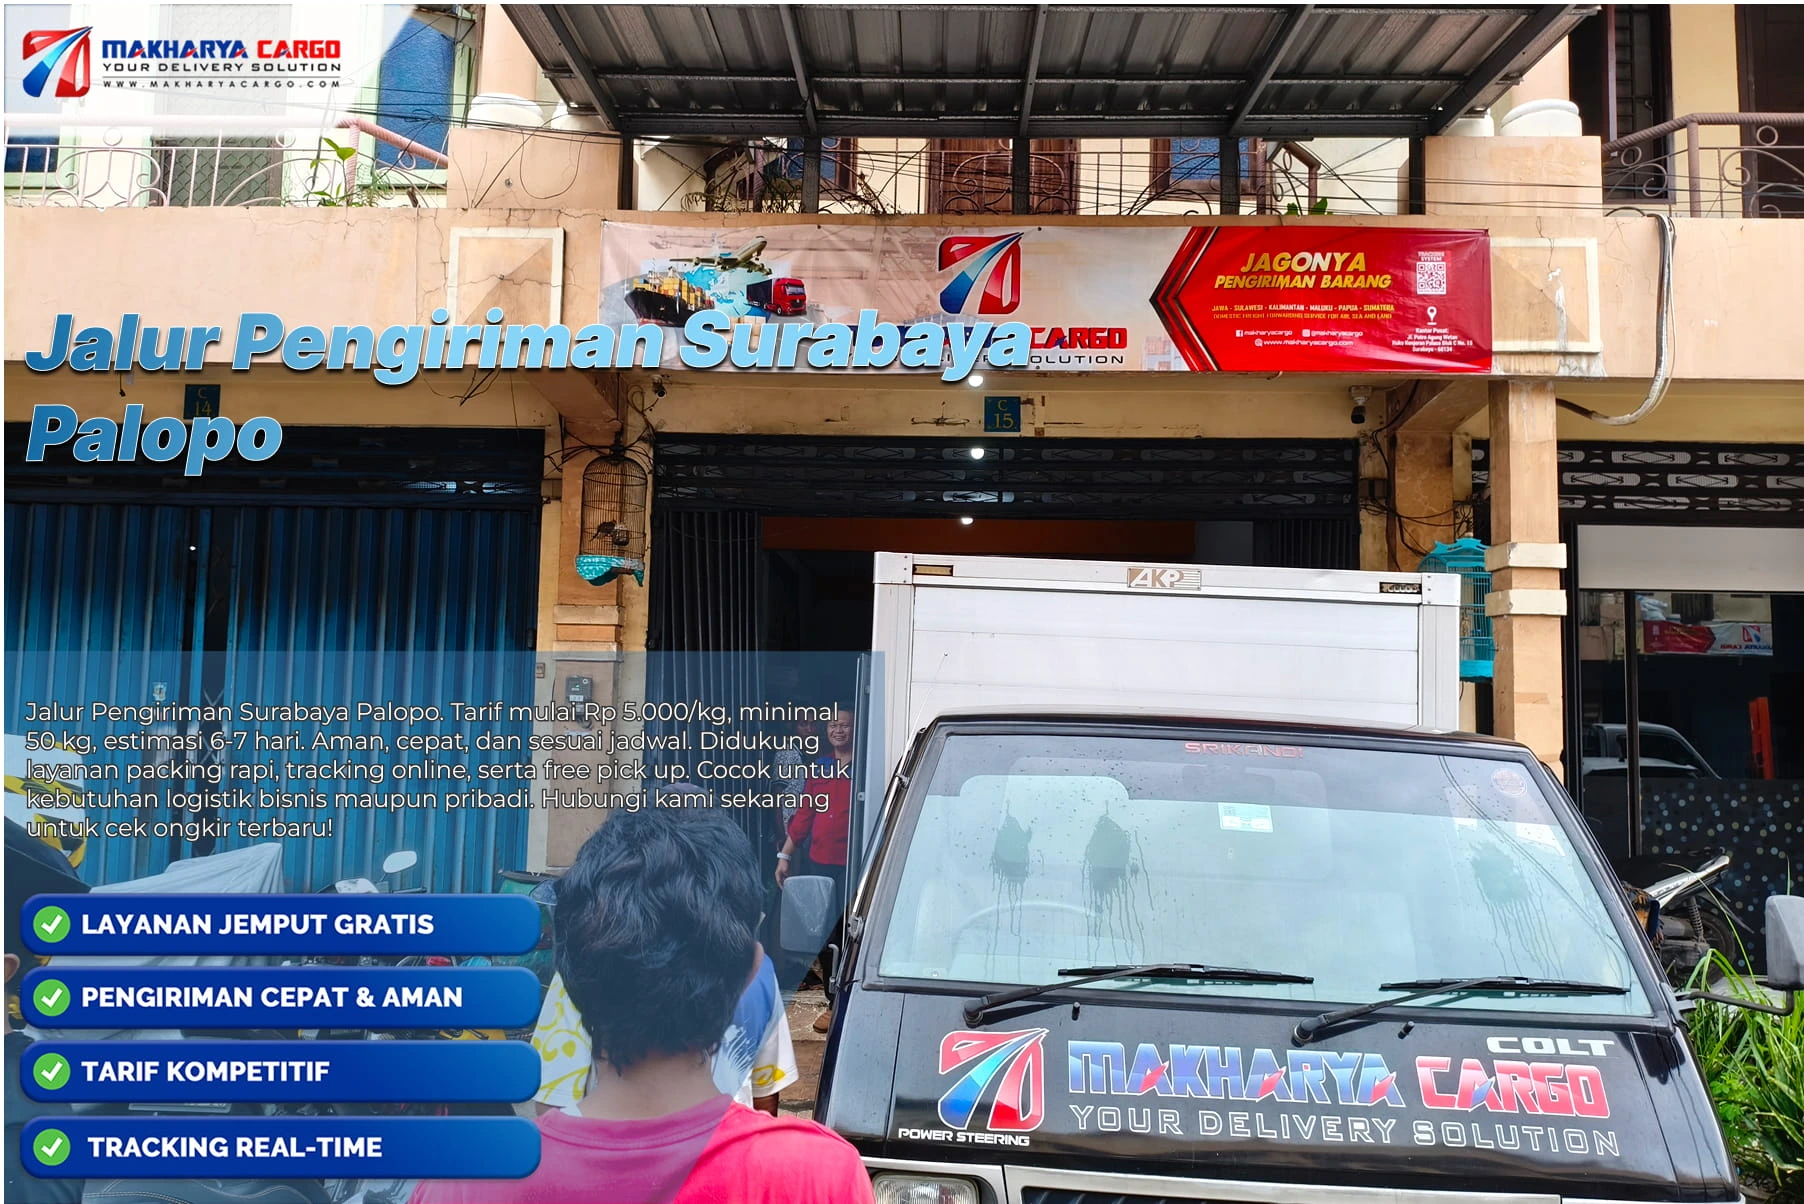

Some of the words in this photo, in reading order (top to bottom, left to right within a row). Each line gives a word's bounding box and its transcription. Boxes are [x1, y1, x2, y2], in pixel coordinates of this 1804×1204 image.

[1240, 252, 1367, 273] JAGONYA
[1214, 274, 1316, 290] PENGIRIMAN
[1320, 274, 1392, 289] BARANG
[1030, 326, 1128, 349] CARGO
[1244, 329, 1293, 337] makharyacargo
[1030, 354, 1125, 365] OLUTION
[198, 386, 209, 400] C
[195, 400, 212, 417] 14
[997, 400, 1008, 412] C
[992, 413, 1015, 430] 15
[1131, 568, 1185, 589] AKP
[1486, 1035, 1615, 1057] COLT
[1067, 1039, 1406, 1108] MAKHARYA
[1415, 1055, 1611, 1119] CARGO
[898, 1127, 953, 1143] POWER
[956, 1130, 1030, 1147] STEERING
[1069, 1104, 1180, 1135] YOUR
[1199, 1109, 1397, 1144] DELIVERY
[1413, 1120, 1620, 1157] SOLUTION
